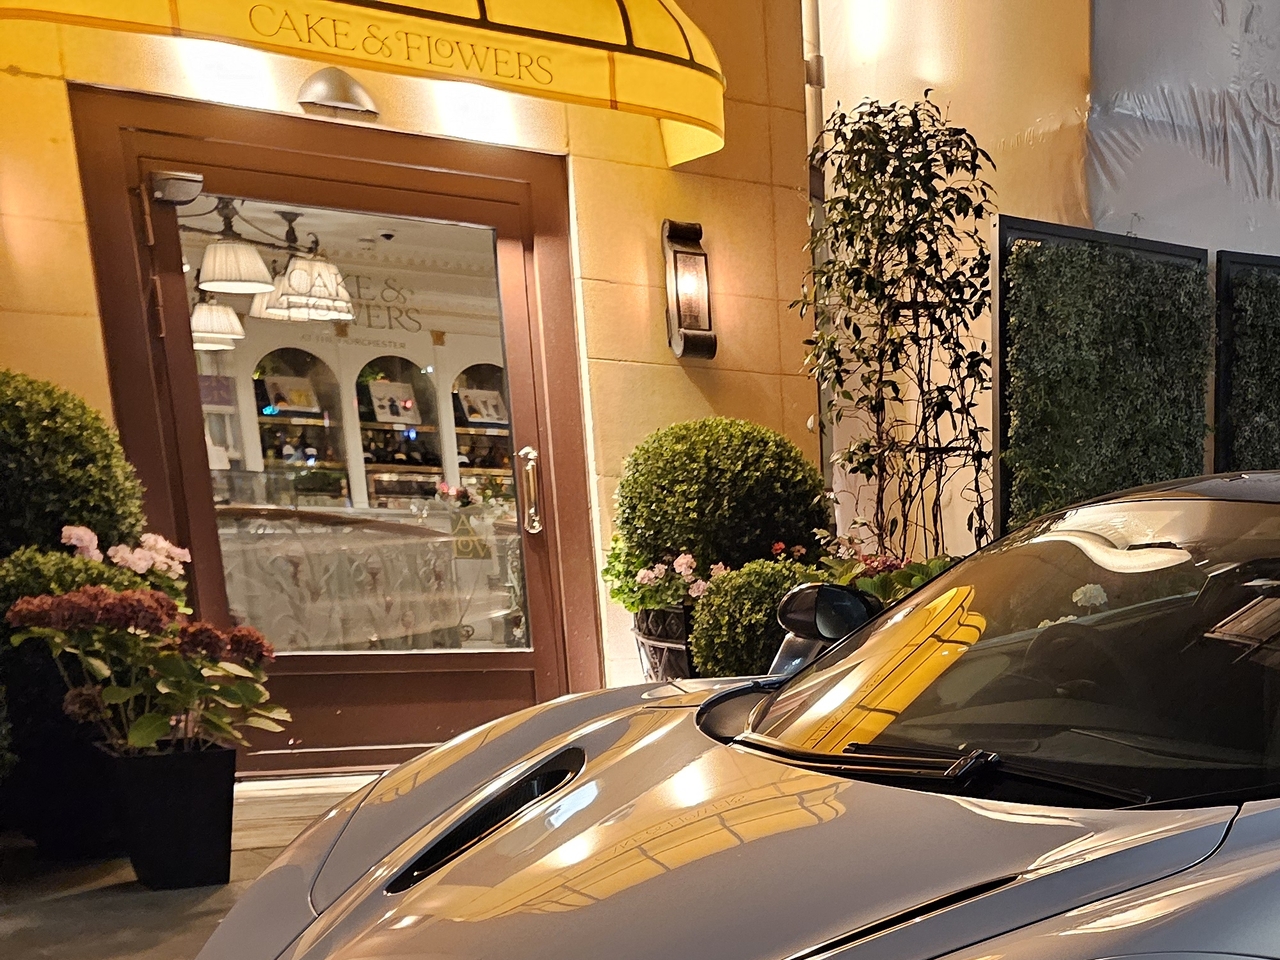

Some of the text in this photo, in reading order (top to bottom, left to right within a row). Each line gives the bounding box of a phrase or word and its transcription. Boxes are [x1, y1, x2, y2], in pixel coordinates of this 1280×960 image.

[249, 4, 554, 85] CAKE & FLOWERS
[288, 268, 415, 305] CAKE &
